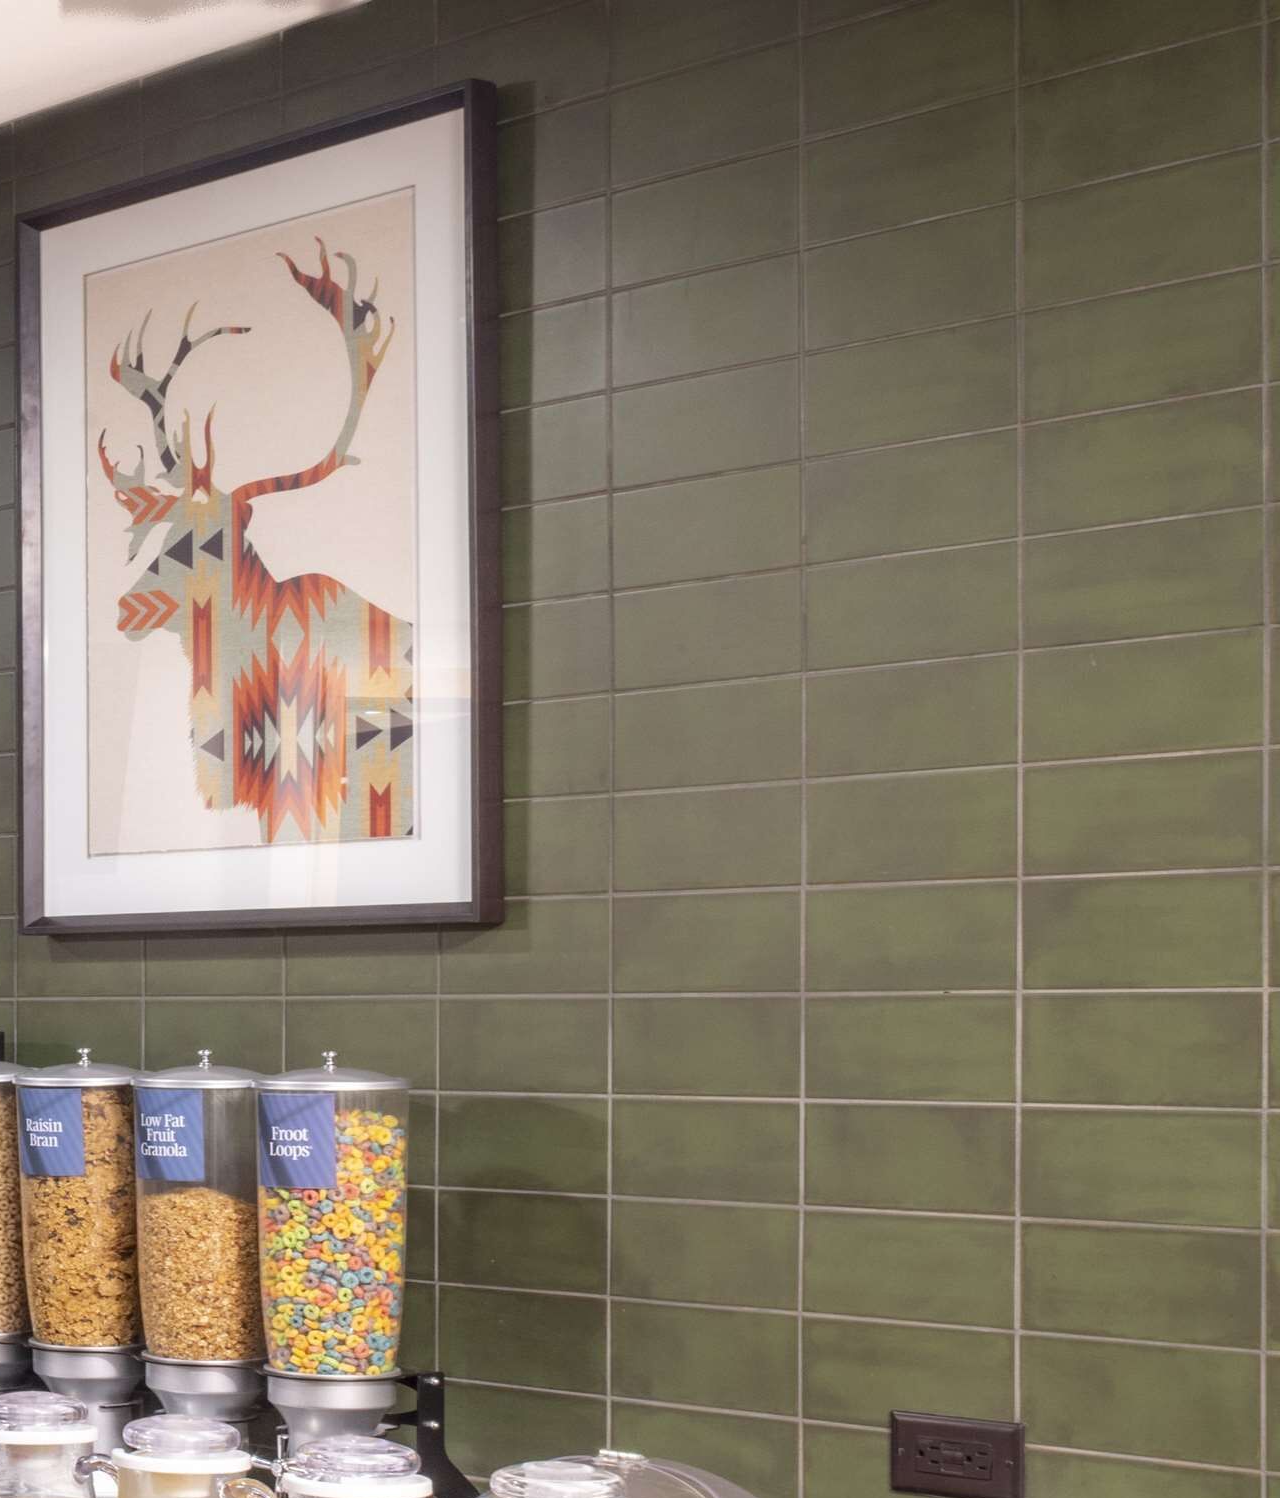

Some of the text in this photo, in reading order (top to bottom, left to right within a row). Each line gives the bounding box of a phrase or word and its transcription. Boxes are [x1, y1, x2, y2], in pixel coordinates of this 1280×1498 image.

[26, 1118, 63, 1133] Raisin
[141, 1113, 185, 1128] Low Fat
[30, 1132, 58, 1147] Bran
[147, 1127, 176, 1142] Fruit
[271, 1125, 309, 1142] Froot
[141, 1142, 187, 1157] Granola
[270, 1141, 311, 1161] Loops
